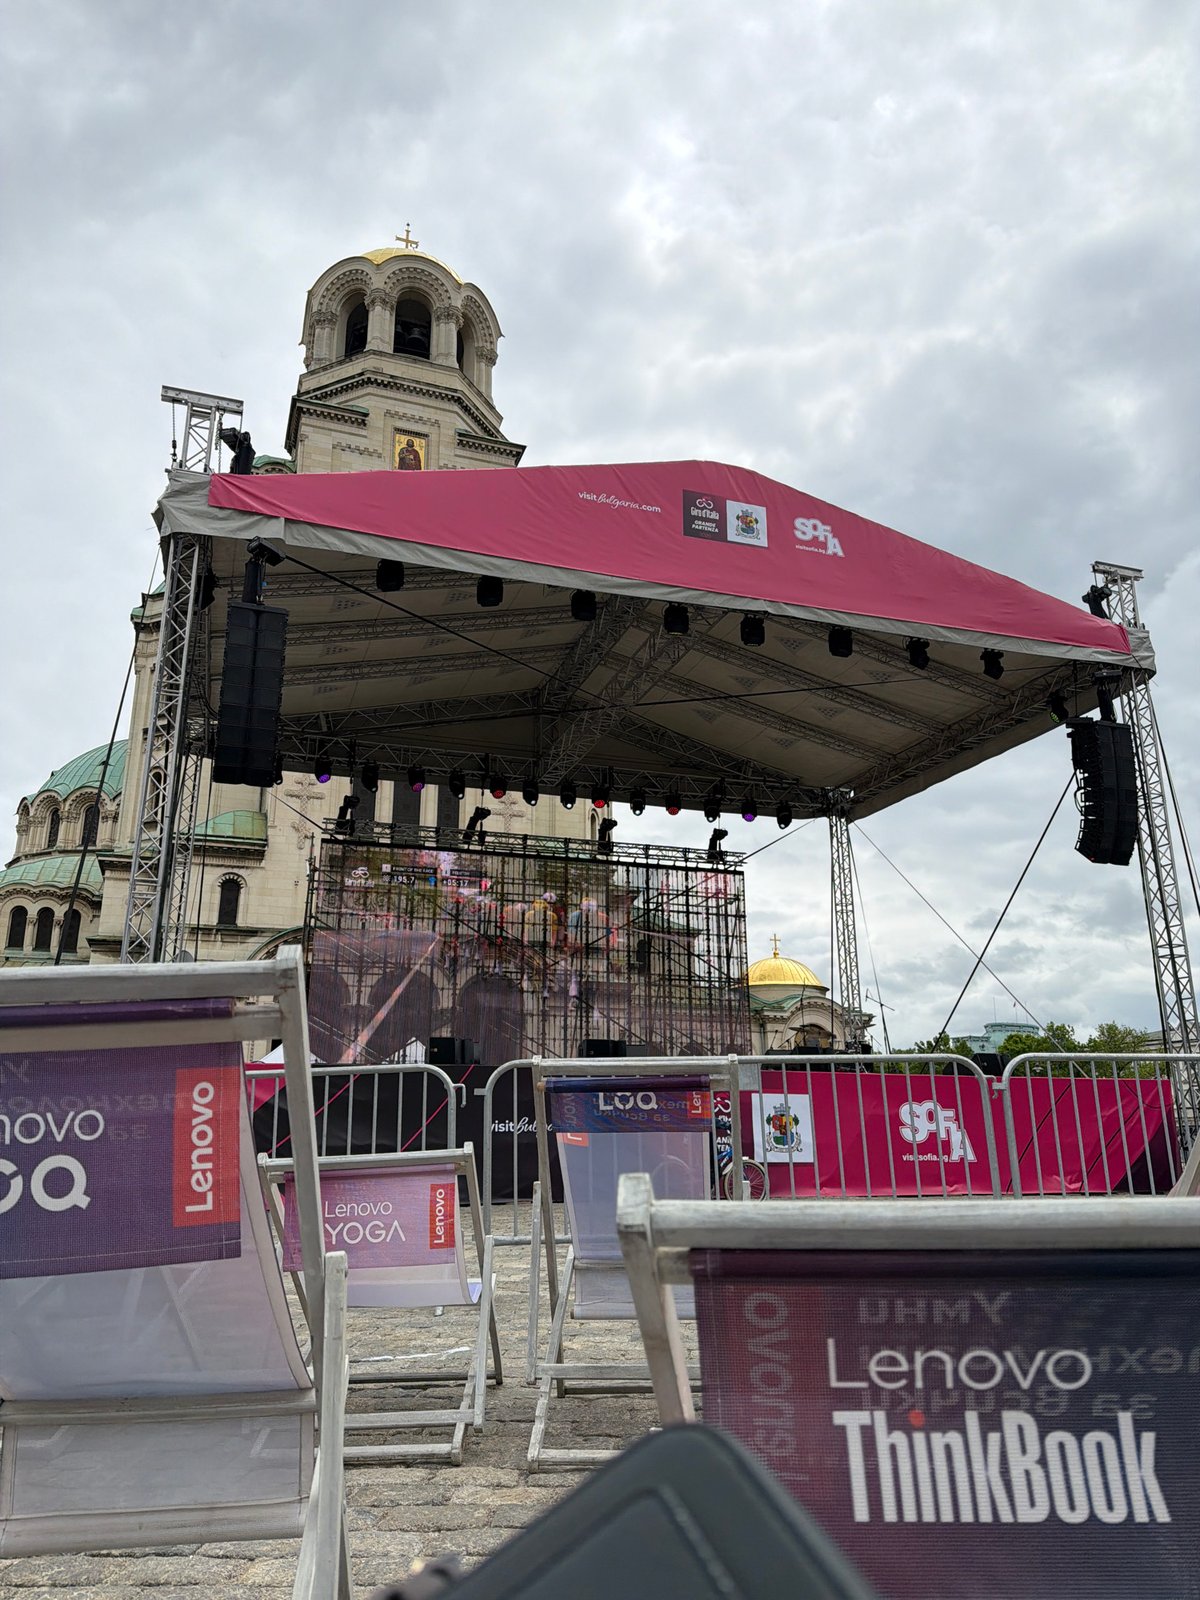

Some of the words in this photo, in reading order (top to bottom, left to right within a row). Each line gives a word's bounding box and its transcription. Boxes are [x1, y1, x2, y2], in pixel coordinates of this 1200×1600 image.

[691, 523, 719, 533] PARTENZA
[694, 519, 717, 528] GRANDE
[794, 517, 845, 558] SOFIA
[599, 1092, 658, 1111] LOQ
[185, 1081, 215, 1213] Lenovo
[324, 1201, 393, 1218] Lenovo
[433, 1188, 445, 1244] Lenovo
[324, 1219, 406, 1246] YOGA
[826, 1338, 1093, 1391] Lenovo
[832, 1409, 1172, 1524] ThinkBook
